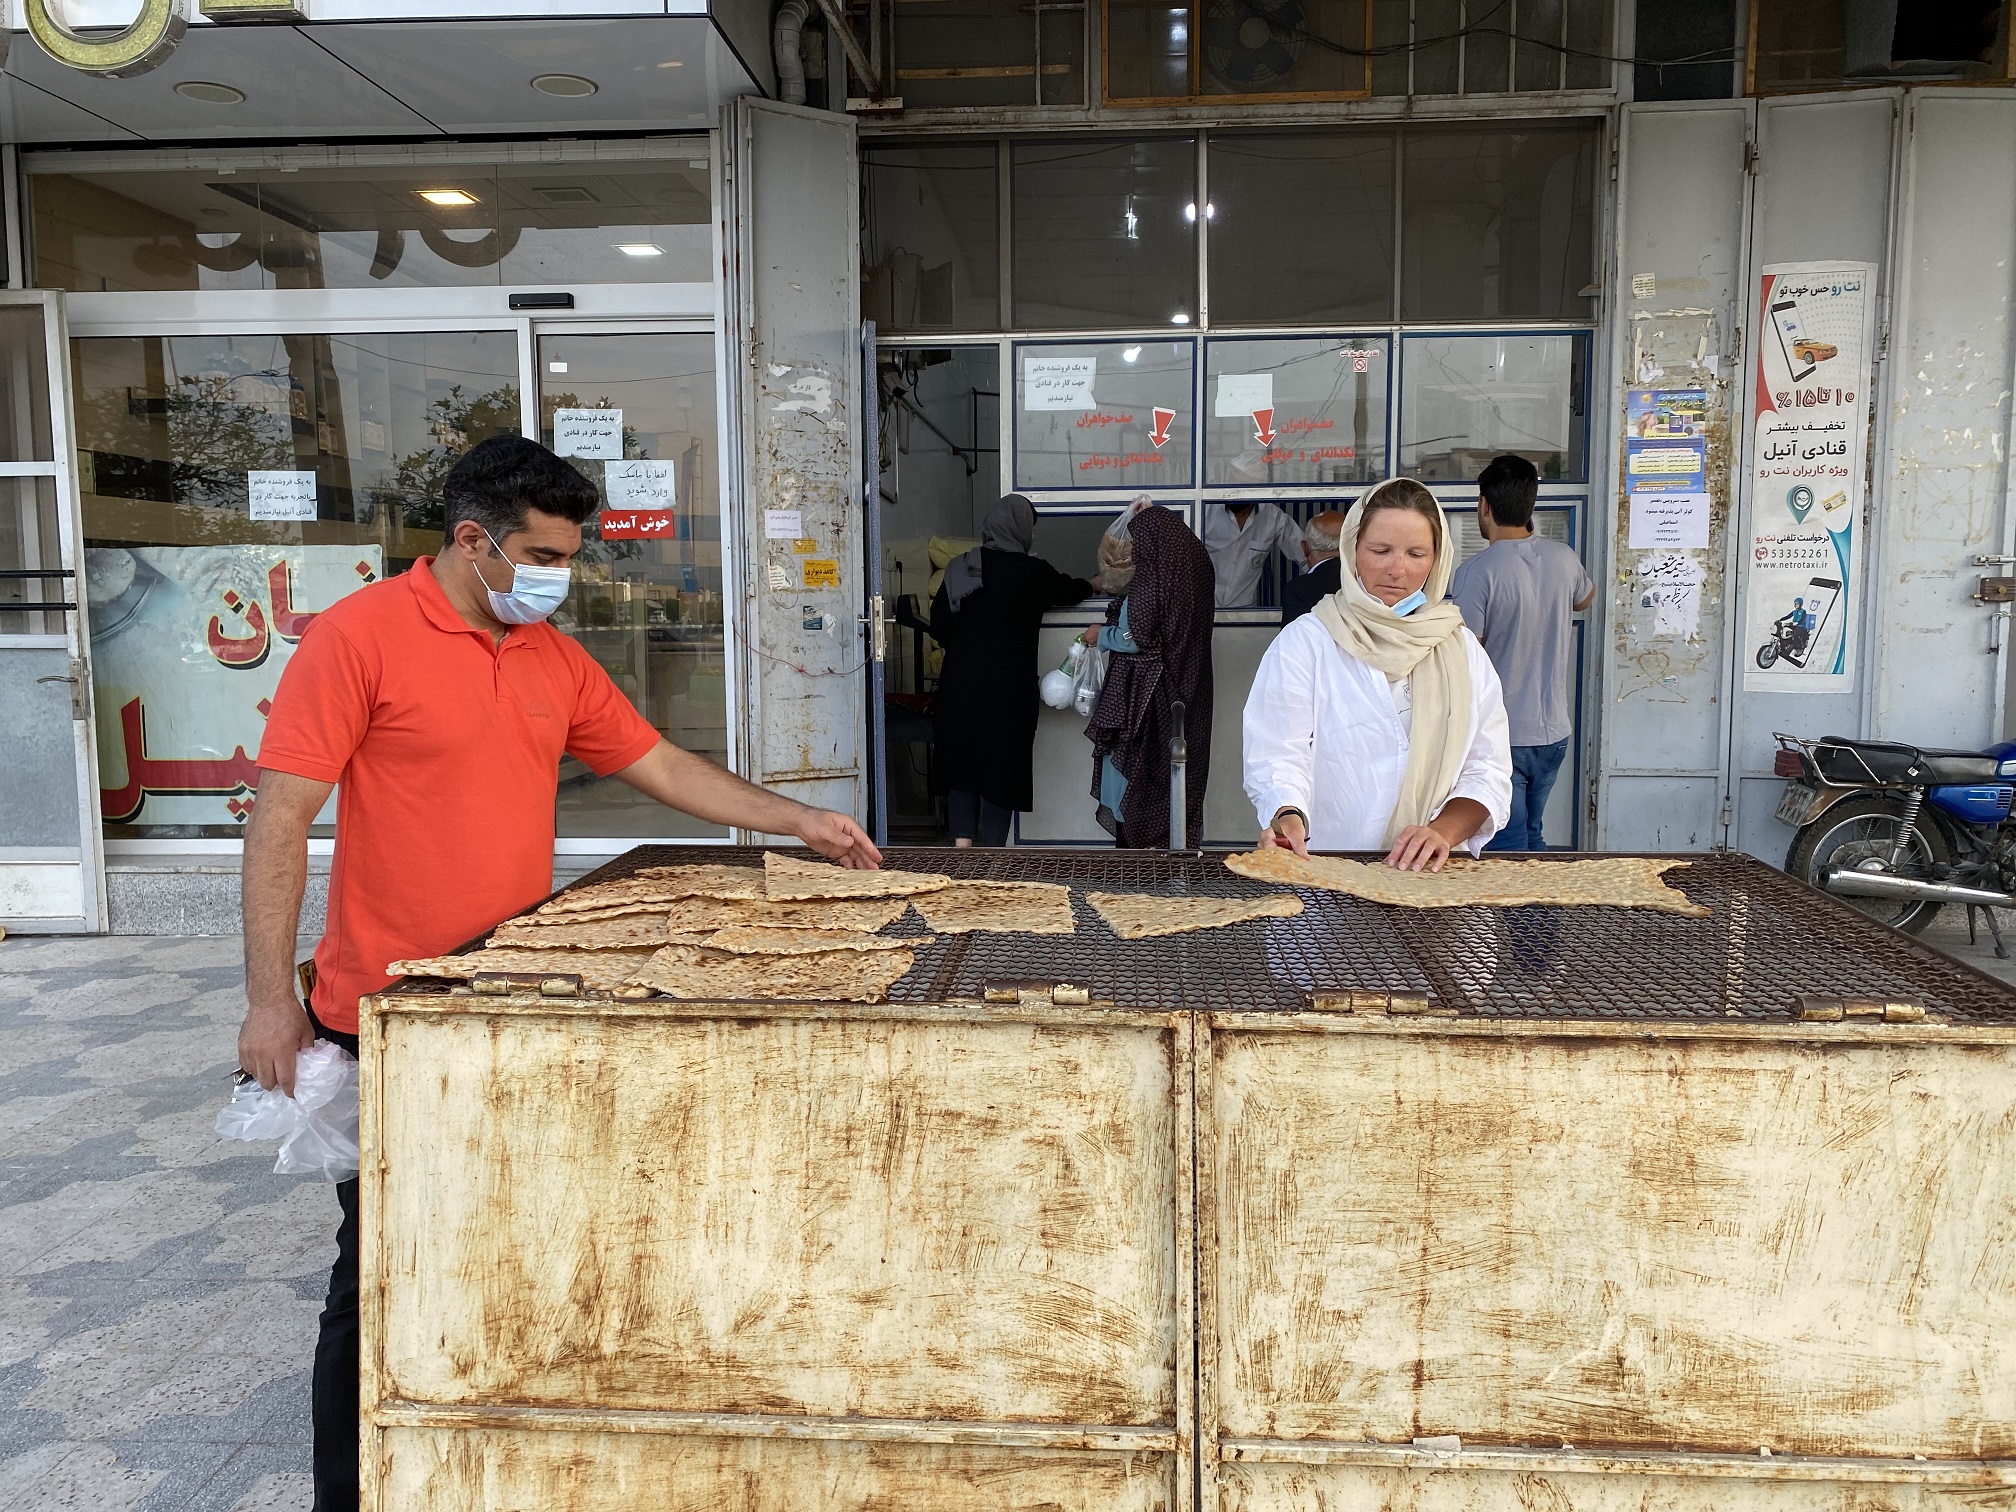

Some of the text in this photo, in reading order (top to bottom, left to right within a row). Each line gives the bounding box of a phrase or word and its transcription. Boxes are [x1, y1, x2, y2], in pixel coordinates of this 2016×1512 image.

[1779, 281, 1860, 298] نت رو حس خوب تو
[1032, 364, 1045, 373] خانم
[1046, 364, 1070, 373] فروشنده
[1035, 380, 1052, 388] قنادی
[1061, 380, 1070, 388] کار
[1047, 394, 1074, 403] نیازمندیم
[575, 415, 598, 423] فروشنده
[1076, 411, 1133, 428] صف خواهران
[1281, 417, 1334, 434] صف برادران
[1767, 421, 1846, 435] تخفیف بیشتر
[563, 428, 580, 438] قنادی
[589, 429, 598, 438] کار
[576, 443, 601, 452] نیازمندیم
[1763, 440, 1847, 461] قنادی آنیل
[1299, 450, 1305, 461] و
[1112, 458, 1119, 468] و
[618, 463, 643, 479] ماسک
[1759, 464, 1849, 478] ویژه کاربران نت رو
[253, 478, 267, 487] خانم
[268, 478, 293, 487] فروشنده
[626, 484, 668, 498] وارد شوید
[263, 492, 273, 501] کار
[274, 493, 289, 501] جهت
[254, 507, 281, 517] نیازمندیم
[295, 508, 313, 517] قنادی
[604, 514, 670, 532] خوش آمدید
[1755, 533, 1830, 545] درخواست تلفنی نت رو
[1771, 548, 1829, 559] 53352261
[1755, 561, 1829, 569] www.netrotaxi.ir
